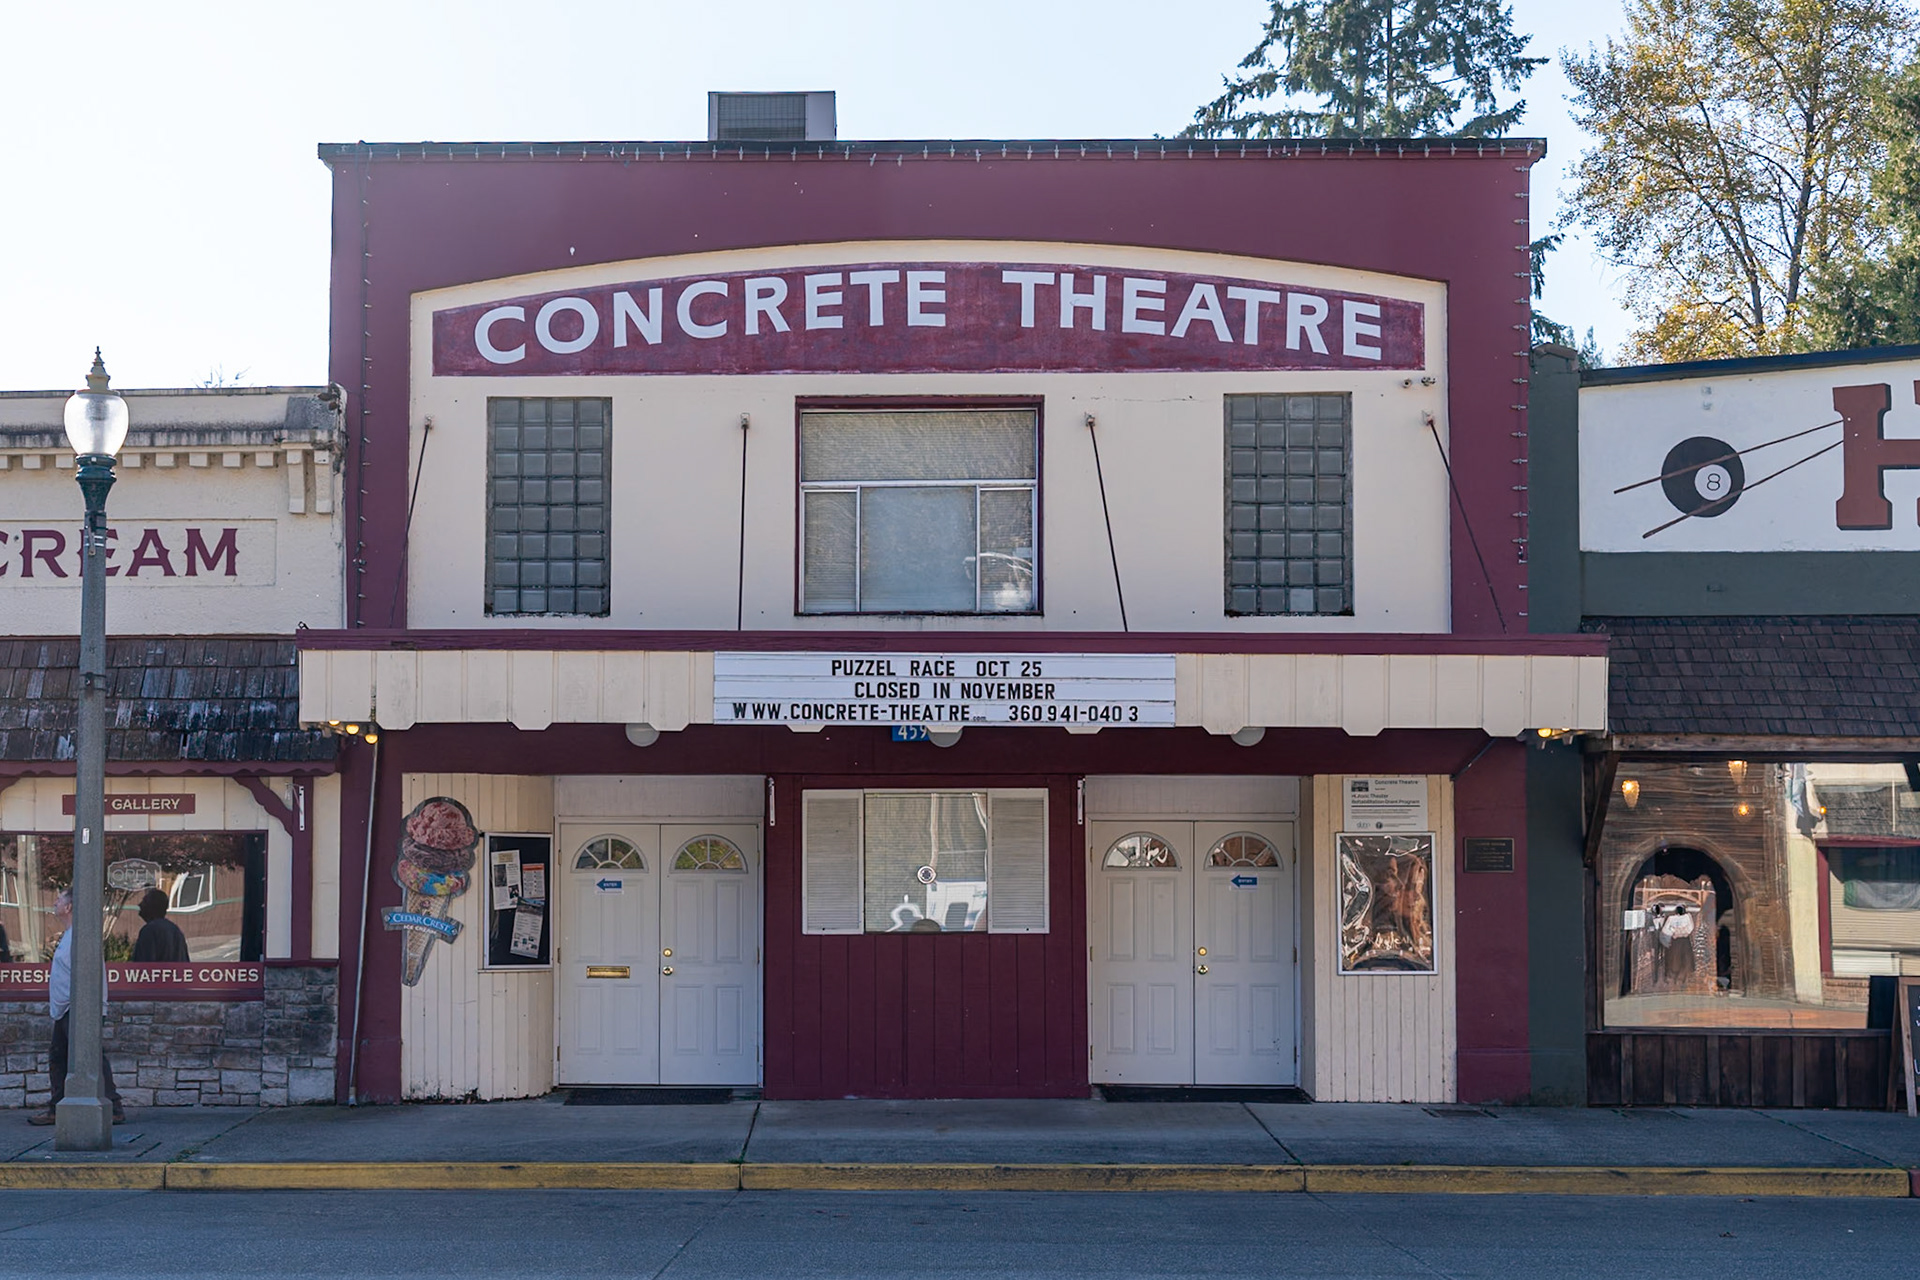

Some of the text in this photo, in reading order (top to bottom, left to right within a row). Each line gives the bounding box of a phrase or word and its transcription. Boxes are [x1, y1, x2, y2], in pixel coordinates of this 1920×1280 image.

[474, 270, 1382, 365] CONCRETE THEATRE
[1706, 473, 1721, 491] 8
[0, 528, 240, 578] RAM
[832, 660, 1042, 677] PUZZEL RACE OCT 25
[855, 682, 1056, 700] CLOSED IN NOVEMBER
[112, 799, 180, 810] GALLERY
[112, 869, 155, 881] OPEN
[393, 914, 449, 931] CEDAR CREST
[415, 926, 436, 934] CREAM
[125, 969, 193, 983] WAFFLE
[199, 968, 259, 982] CONES
